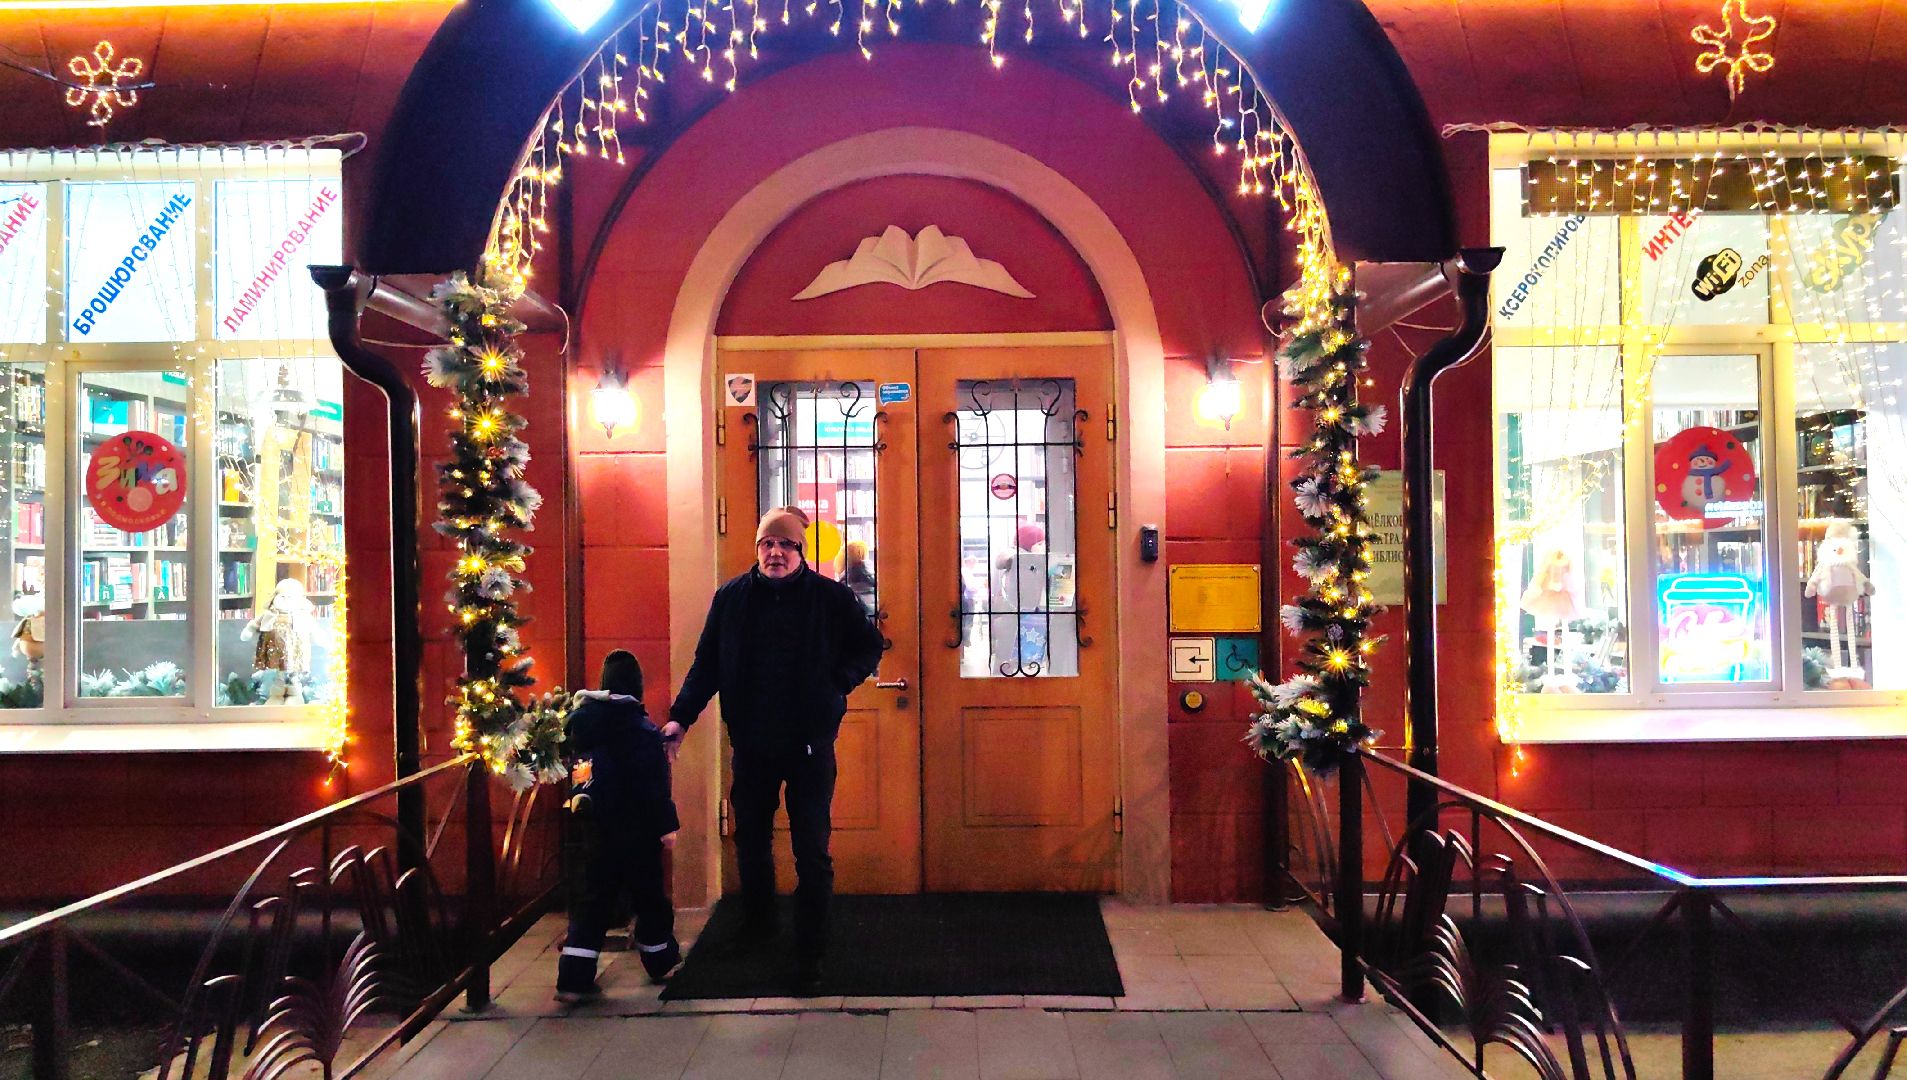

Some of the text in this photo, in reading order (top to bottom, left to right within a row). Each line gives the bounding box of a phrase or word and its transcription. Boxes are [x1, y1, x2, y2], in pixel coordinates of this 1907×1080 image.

[72, 192, 192, 336] БРОШЮРОВАНИЕ
[223, 186, 338, 333] ЛАМИНИРОВАНИЕ
[1642, 209, 1697, 261] ИНТЕ
[1738, 254, 1769, 288] zona
